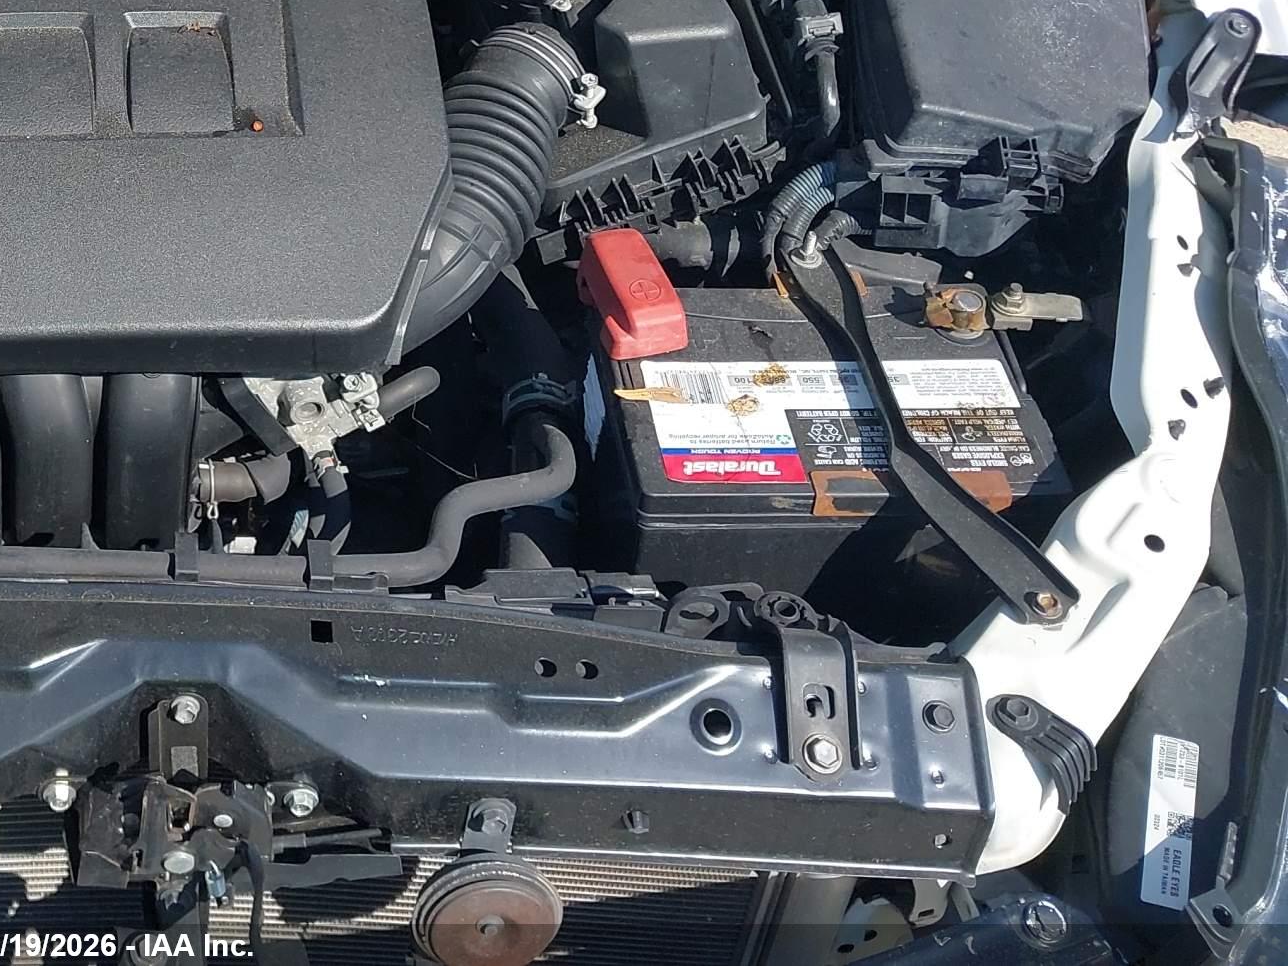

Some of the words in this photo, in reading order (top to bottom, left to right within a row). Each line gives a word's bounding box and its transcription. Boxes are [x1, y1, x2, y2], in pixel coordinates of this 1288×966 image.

[683, 459, 782, 476] Duralast
[1172, 849, 1182, 874] EAGLE
[1170, 876, 1180, 898] EYES
